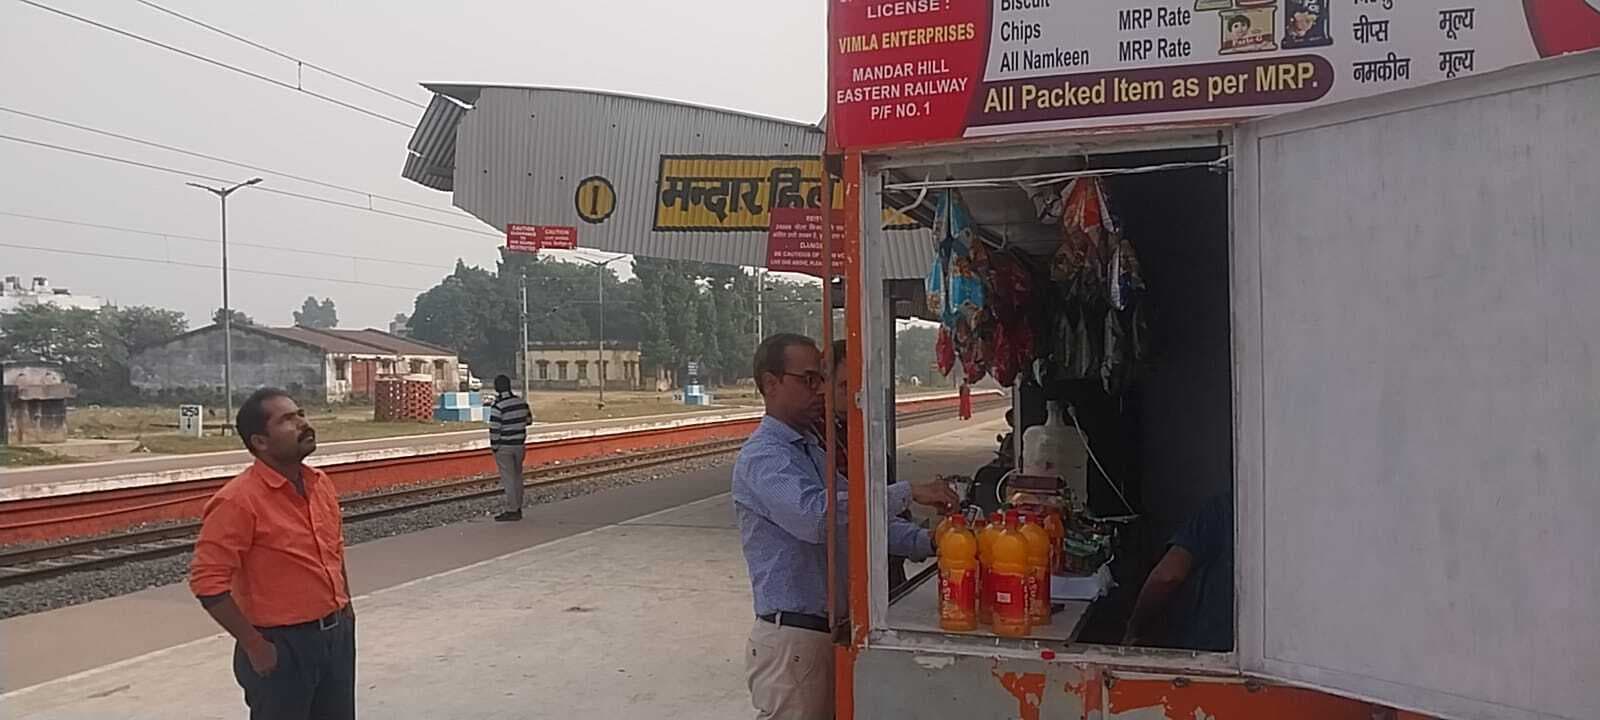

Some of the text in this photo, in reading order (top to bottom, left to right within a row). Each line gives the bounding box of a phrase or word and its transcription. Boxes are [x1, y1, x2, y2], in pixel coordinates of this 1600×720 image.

[867, 0, 940, 18] LICENSE
[1119, 7, 1191, 30] MRP Rate
[1001, 20, 1041, 44] Chips
[1353, 14, 1390, 43] चीप्स
[1438, 8, 1475, 40] मूल्य
[838, 22, 976, 54] VIMLA ENTERPRISES
[1119, 38, 1191, 62] MRP Rate
[852, 59, 950, 83] MANDAR HILL
[1000, 47, 1090, 73] All Namkeen
[1353, 52, 1411, 83] नमकीन
[1438, 49, 1475, 79] मूल्य
[836, 77, 968, 104] EASTERN RAILWAY
[984, 62, 1318, 113] All Packed Item as per MRP.
[871, 102, 930, 120] P/F NO. 1
[662, 177, 765, 223] मन्दार
